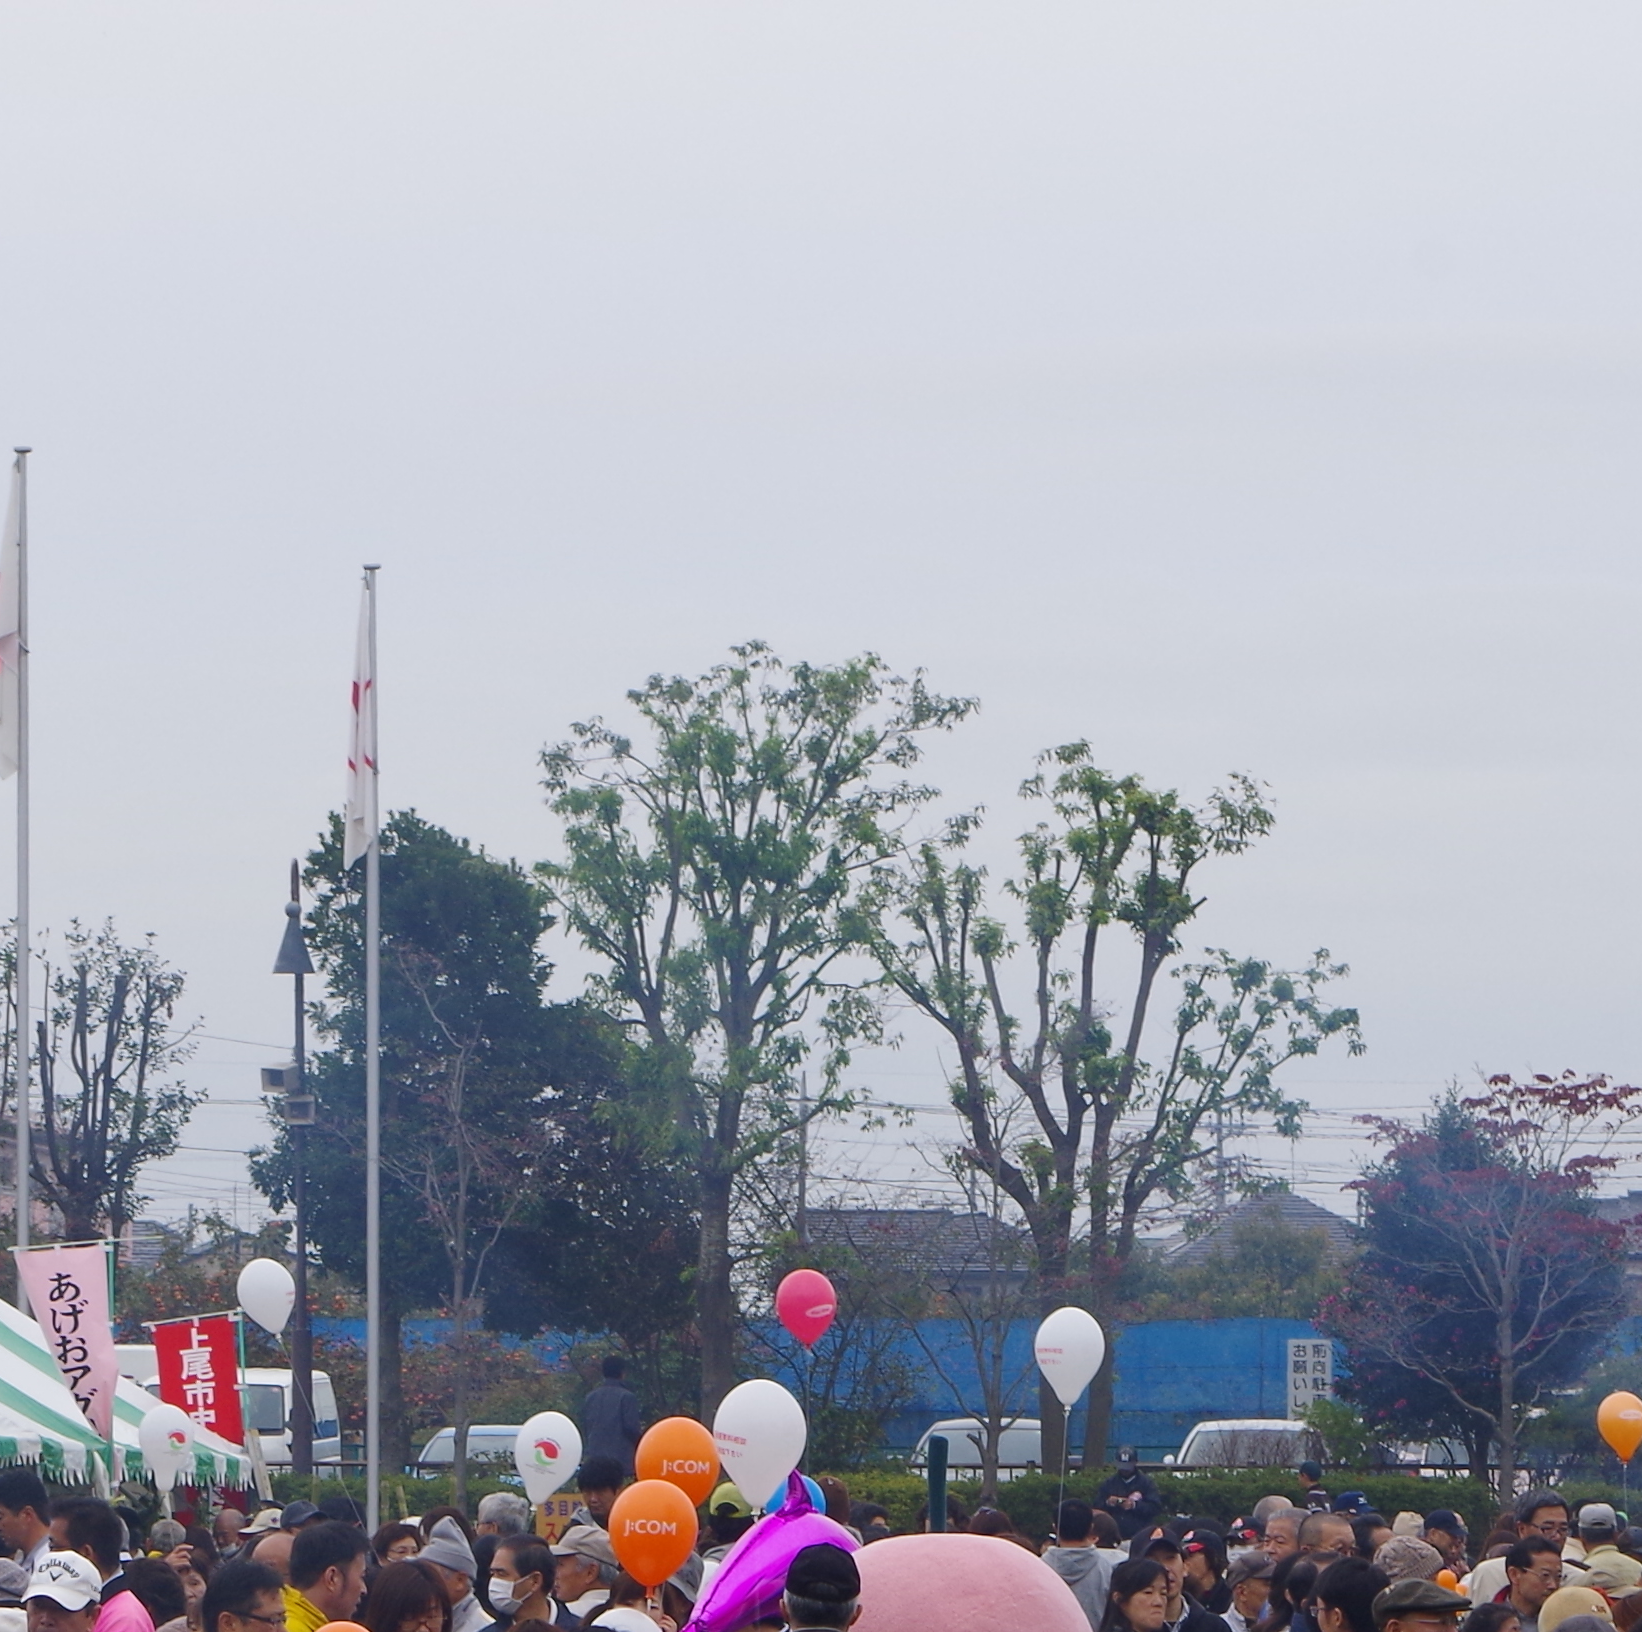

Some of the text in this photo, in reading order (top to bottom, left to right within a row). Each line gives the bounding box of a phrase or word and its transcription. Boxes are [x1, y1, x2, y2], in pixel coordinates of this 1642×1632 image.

[1293, 1344, 1307, 1421] お願いし
[1312, 1343, 1328, 1402] 前向駐
[661, 1459, 710, 1476] J:COM
[623, 1519, 677, 1537] J:COM
